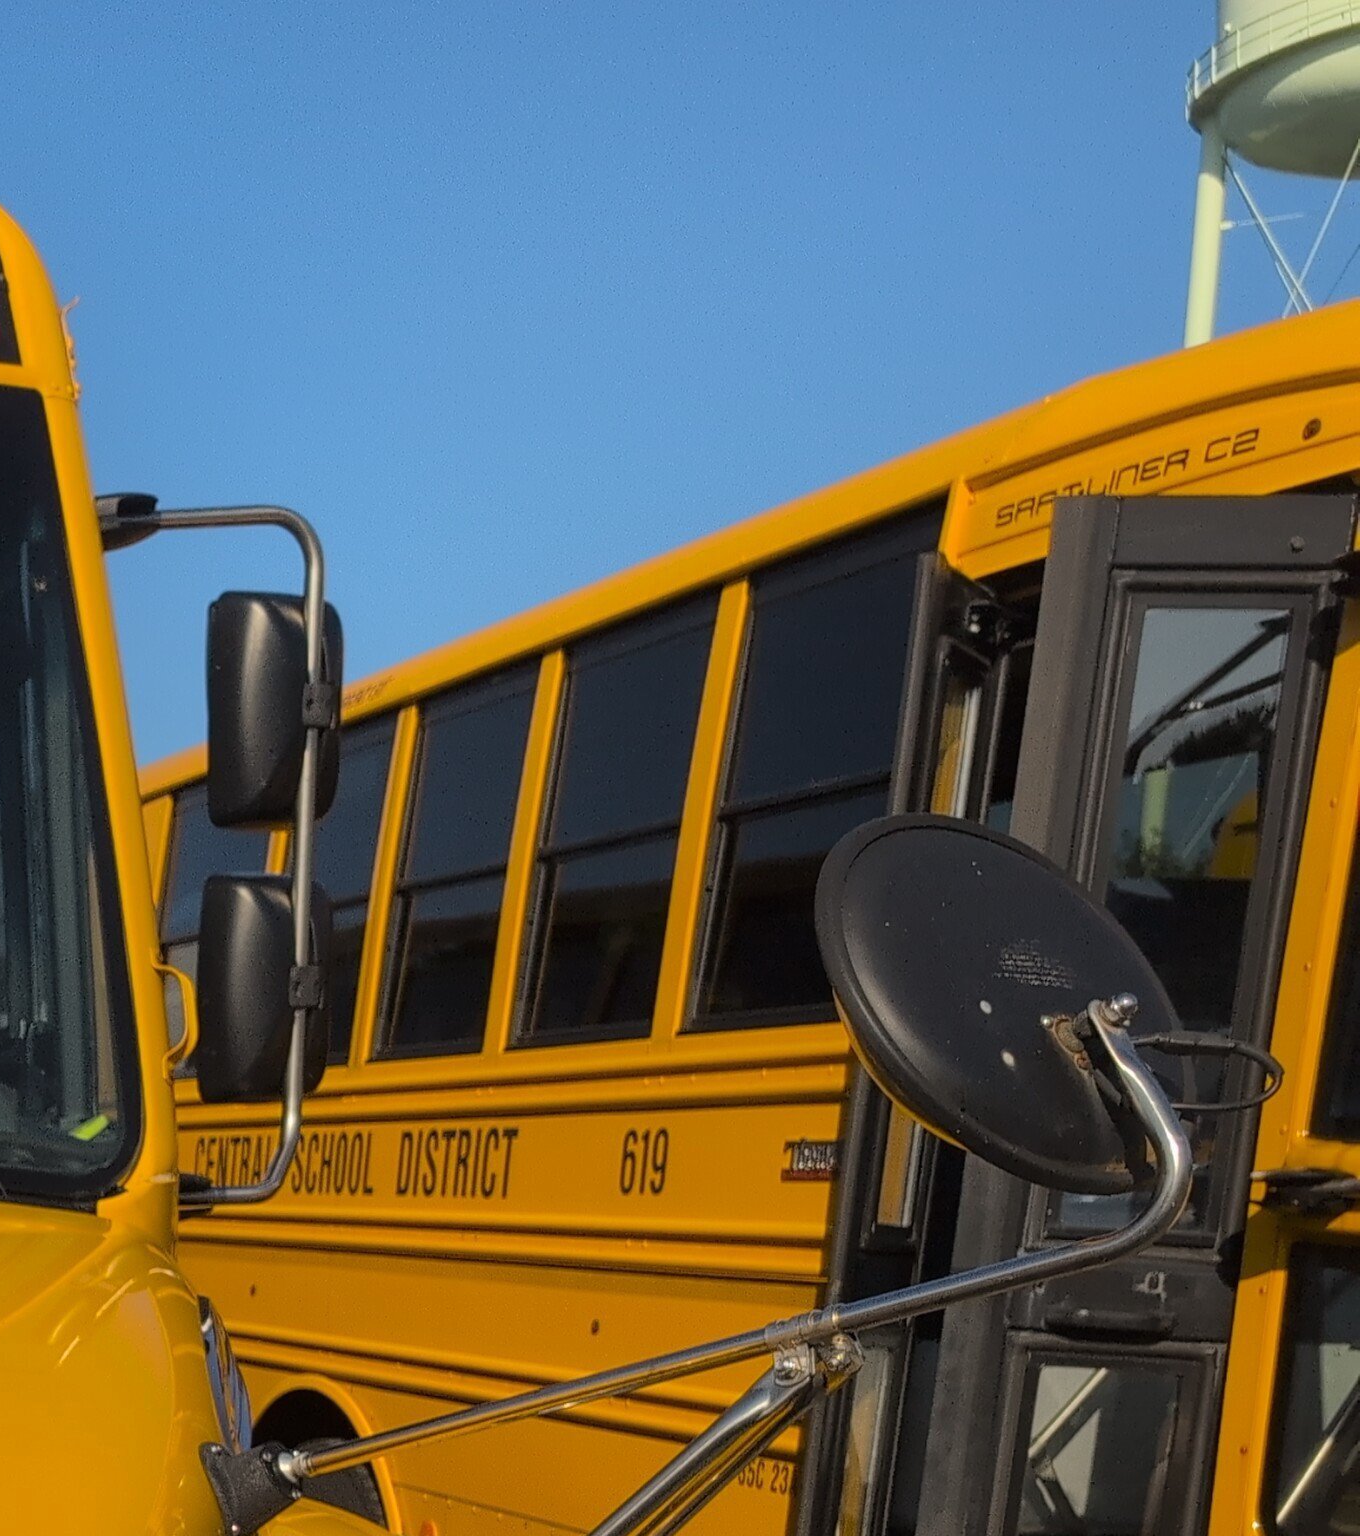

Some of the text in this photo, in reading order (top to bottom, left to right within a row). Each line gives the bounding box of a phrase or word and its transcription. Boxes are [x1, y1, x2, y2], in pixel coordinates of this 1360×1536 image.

[1204, 427, 1260, 464] C2
[194, 1126, 670, 1200] CENTRAL SCHOOL DISTRICT 619
